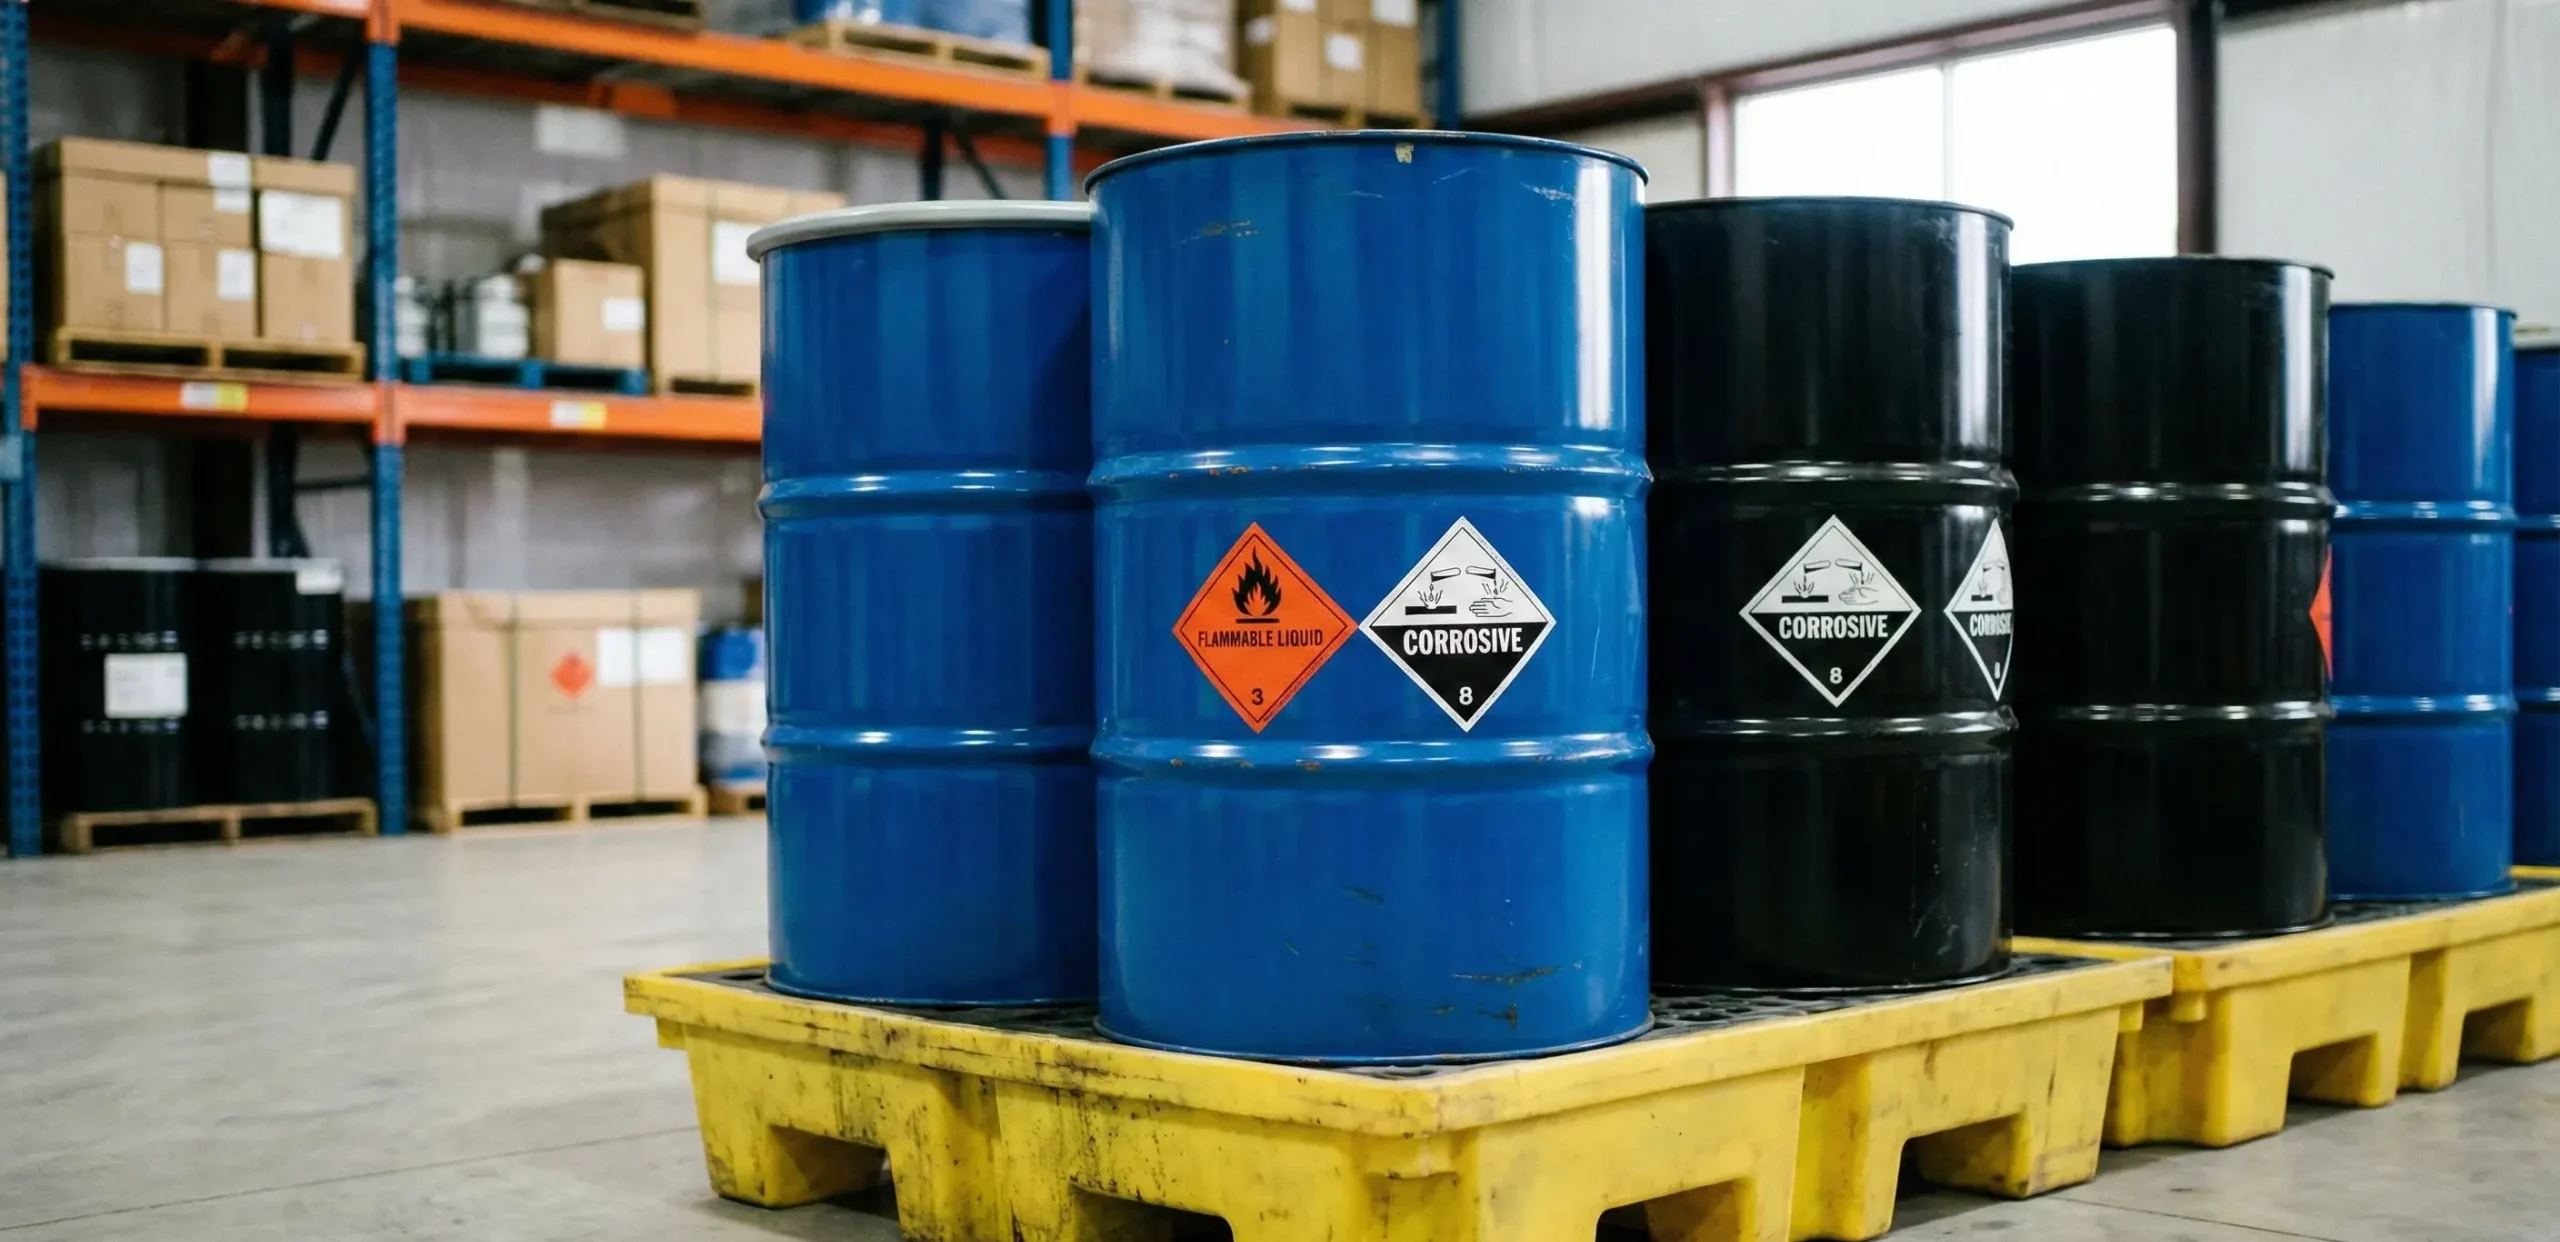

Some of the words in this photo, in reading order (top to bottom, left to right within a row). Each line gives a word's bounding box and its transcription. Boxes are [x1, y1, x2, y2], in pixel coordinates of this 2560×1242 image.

[1779, 615, 1888, 640] CORROSIVE
[1198, 629, 1273, 648] FLAMMABLE
[1278, 628, 1323, 647] LIQUID
[1403, 627, 1523, 655] CORROSIVE
[1829, 667, 1843, 684] 8
[1251, 689, 1264, 706] 3
[1459, 686, 1473, 705] 8
